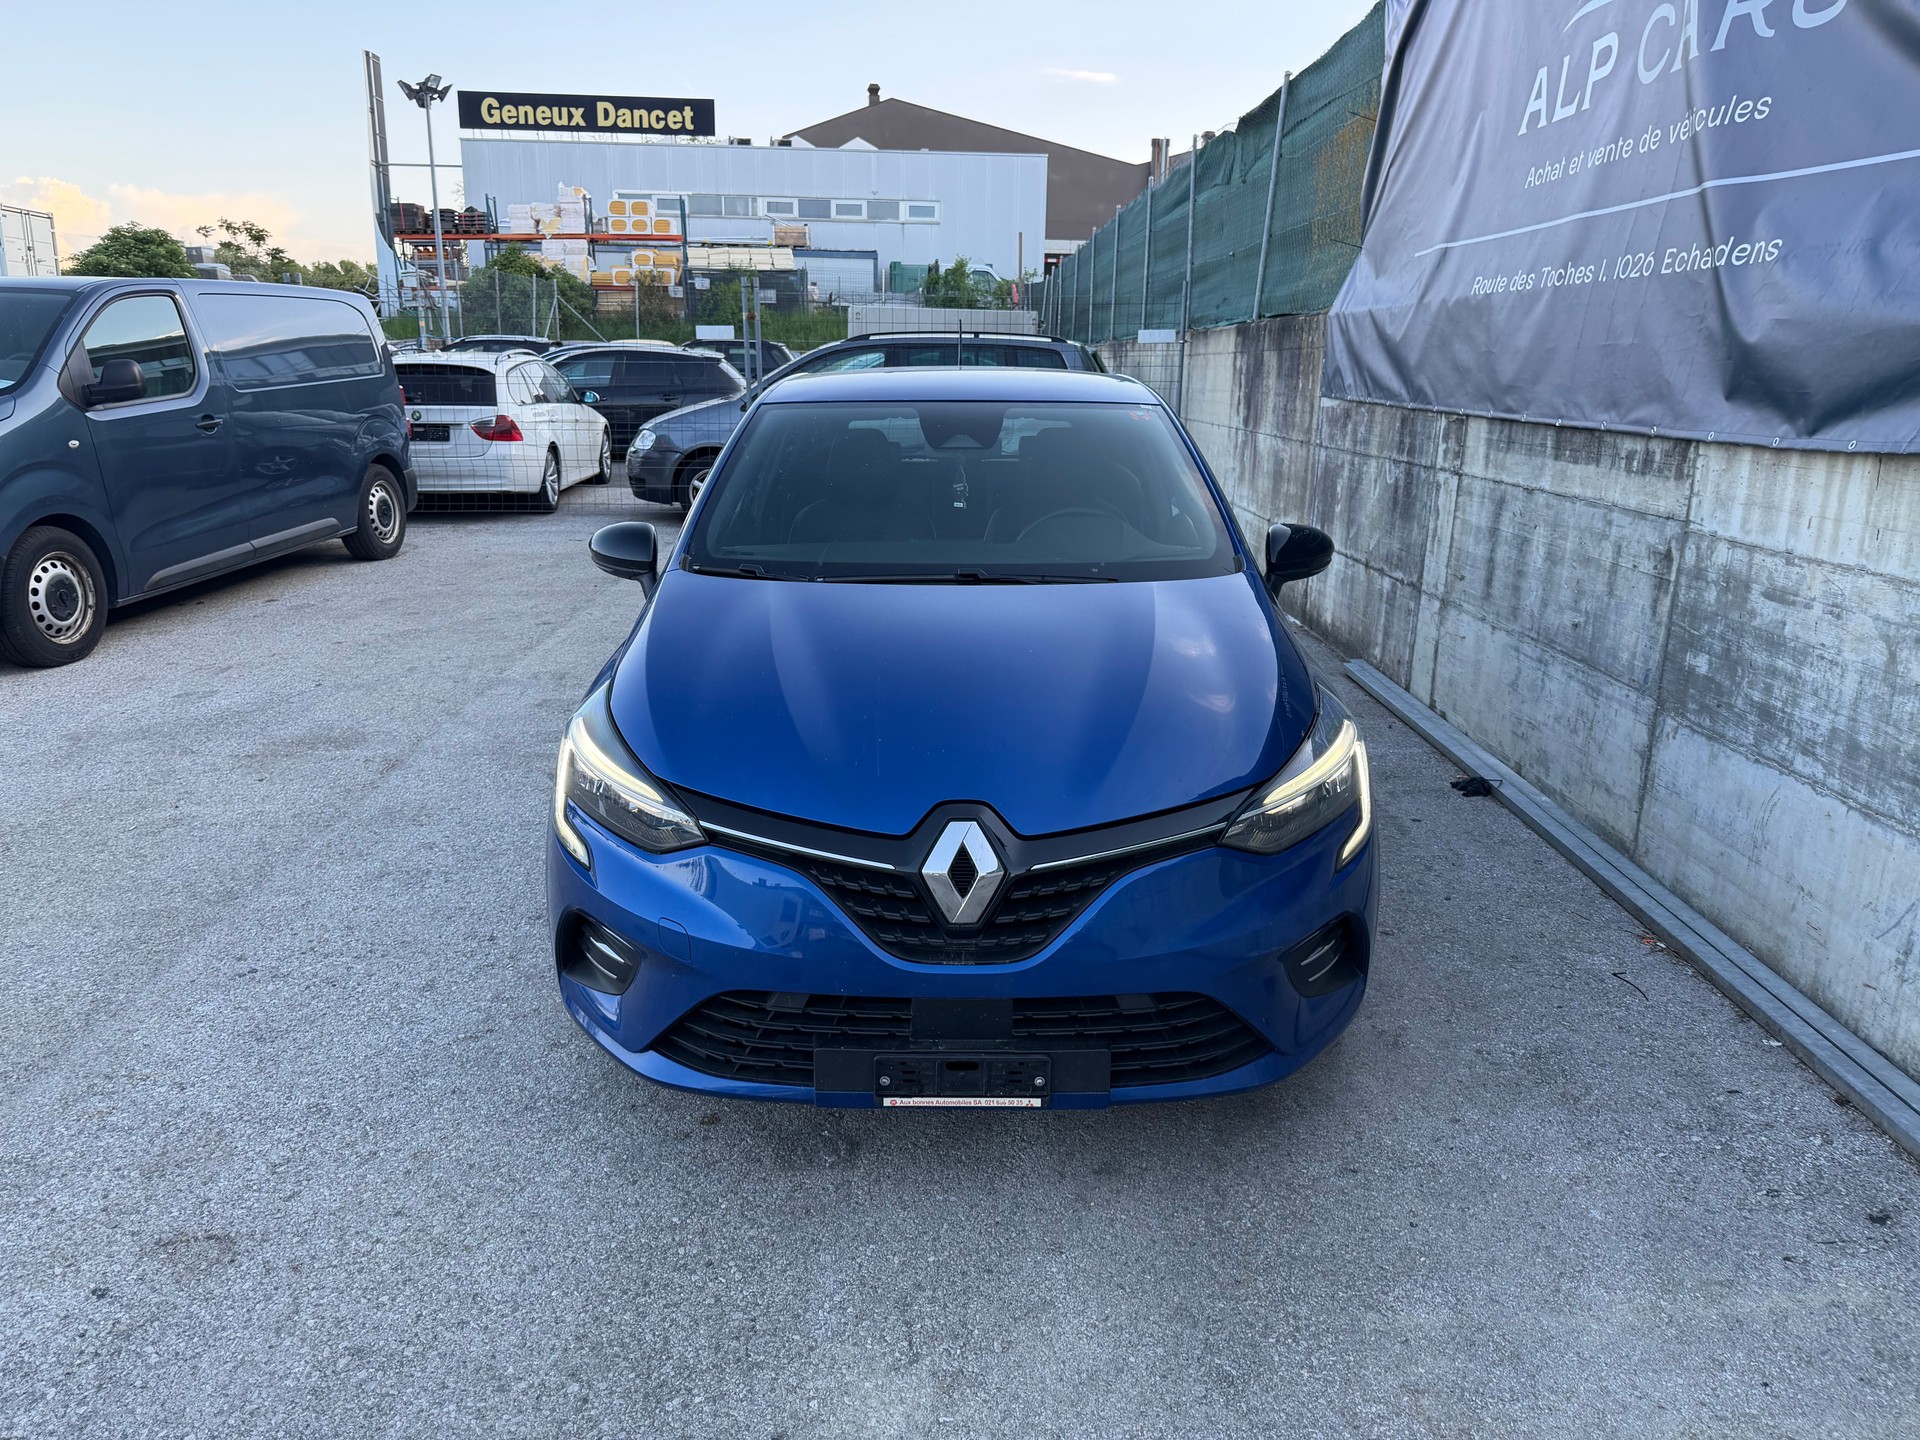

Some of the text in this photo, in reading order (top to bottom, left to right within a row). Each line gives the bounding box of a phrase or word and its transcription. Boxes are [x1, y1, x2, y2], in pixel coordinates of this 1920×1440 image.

[1518, 0, 1847, 136] ALP CAR
[481, 97, 694, 130] Geneux Dancet
[1525, 157, 1565, 188] Achat
[1569, 150, 1584, 175] et
[1587, 137, 1633, 168] vente
[1639, 125, 1661, 154] de
[1471, 273, 1507, 295] Route
[1509, 270, 1535, 291] des
[1540, 261, 1595, 288] Toches
[1613, 251, 1655, 279] 1026
